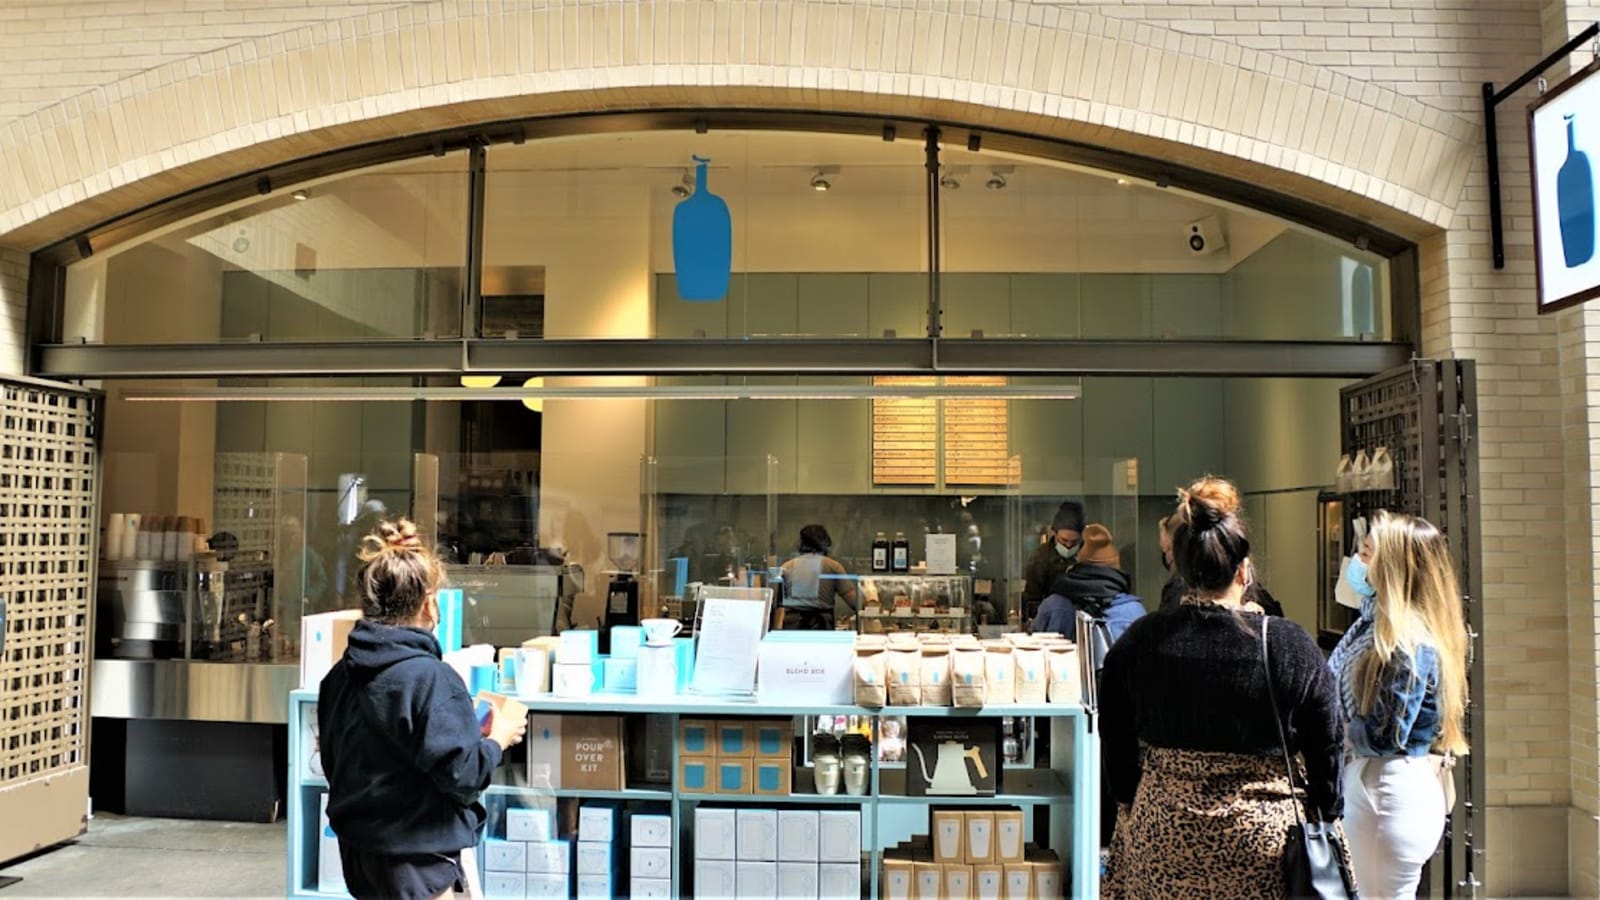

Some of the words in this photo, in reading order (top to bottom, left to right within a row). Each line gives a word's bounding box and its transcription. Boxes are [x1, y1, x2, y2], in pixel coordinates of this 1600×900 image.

[575, 743, 604, 751] POUR
[575, 753, 604, 762] OVER
[581, 763, 598, 772] KIT
